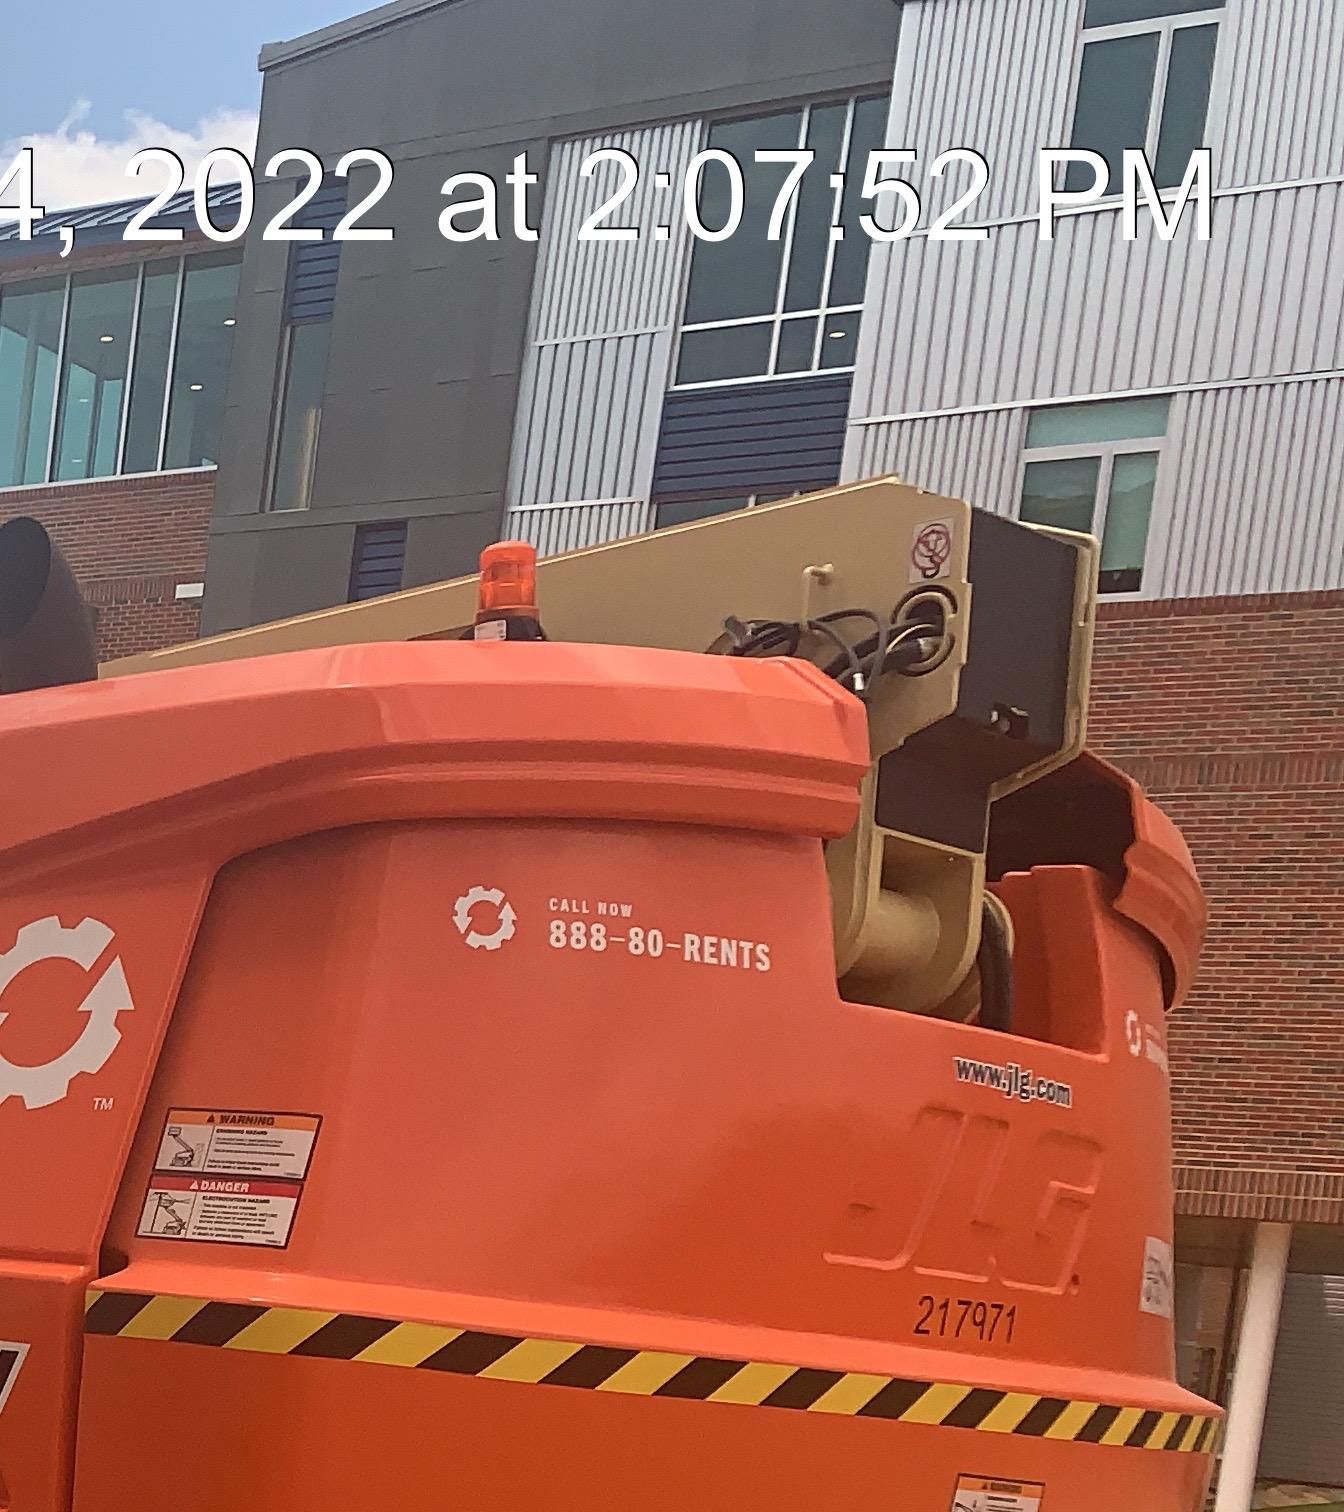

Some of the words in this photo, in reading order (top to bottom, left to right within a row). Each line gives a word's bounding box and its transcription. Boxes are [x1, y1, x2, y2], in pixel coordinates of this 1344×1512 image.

[549, 897, 590, 914] CALL
[597, 901, 633, 918] NOW
[549, 918, 772, 973] 888-80-RENTS
[953, 1056, 1073, 1108] www.jlg.com
[93, 1097, 114, 1111] TM
[219, 1114, 275, 1127] WARNING
[200, 1180, 250, 1194] DANGER
[913, 1295, 1018, 1343] 217971
